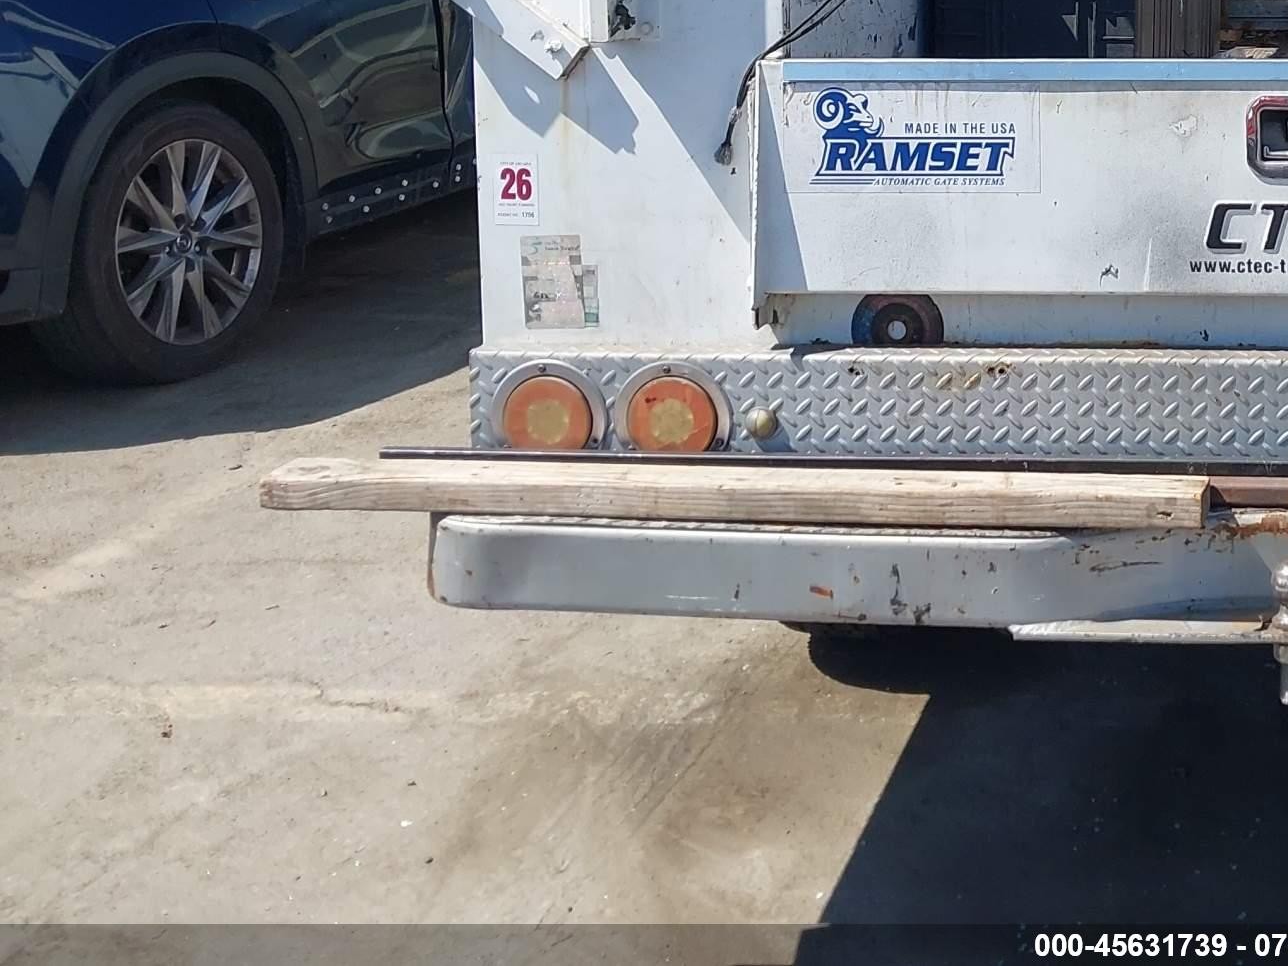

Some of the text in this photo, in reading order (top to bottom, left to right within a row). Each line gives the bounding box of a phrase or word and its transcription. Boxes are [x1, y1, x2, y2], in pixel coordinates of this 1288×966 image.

[904, 122, 1016, 134] MADE IN THE USA
[823, 141, 1010, 172] RAMSET
[500, 167, 532, 201] 26
[873, 177, 1006, 186] AUTOMATIC GATE SYSTEMS
